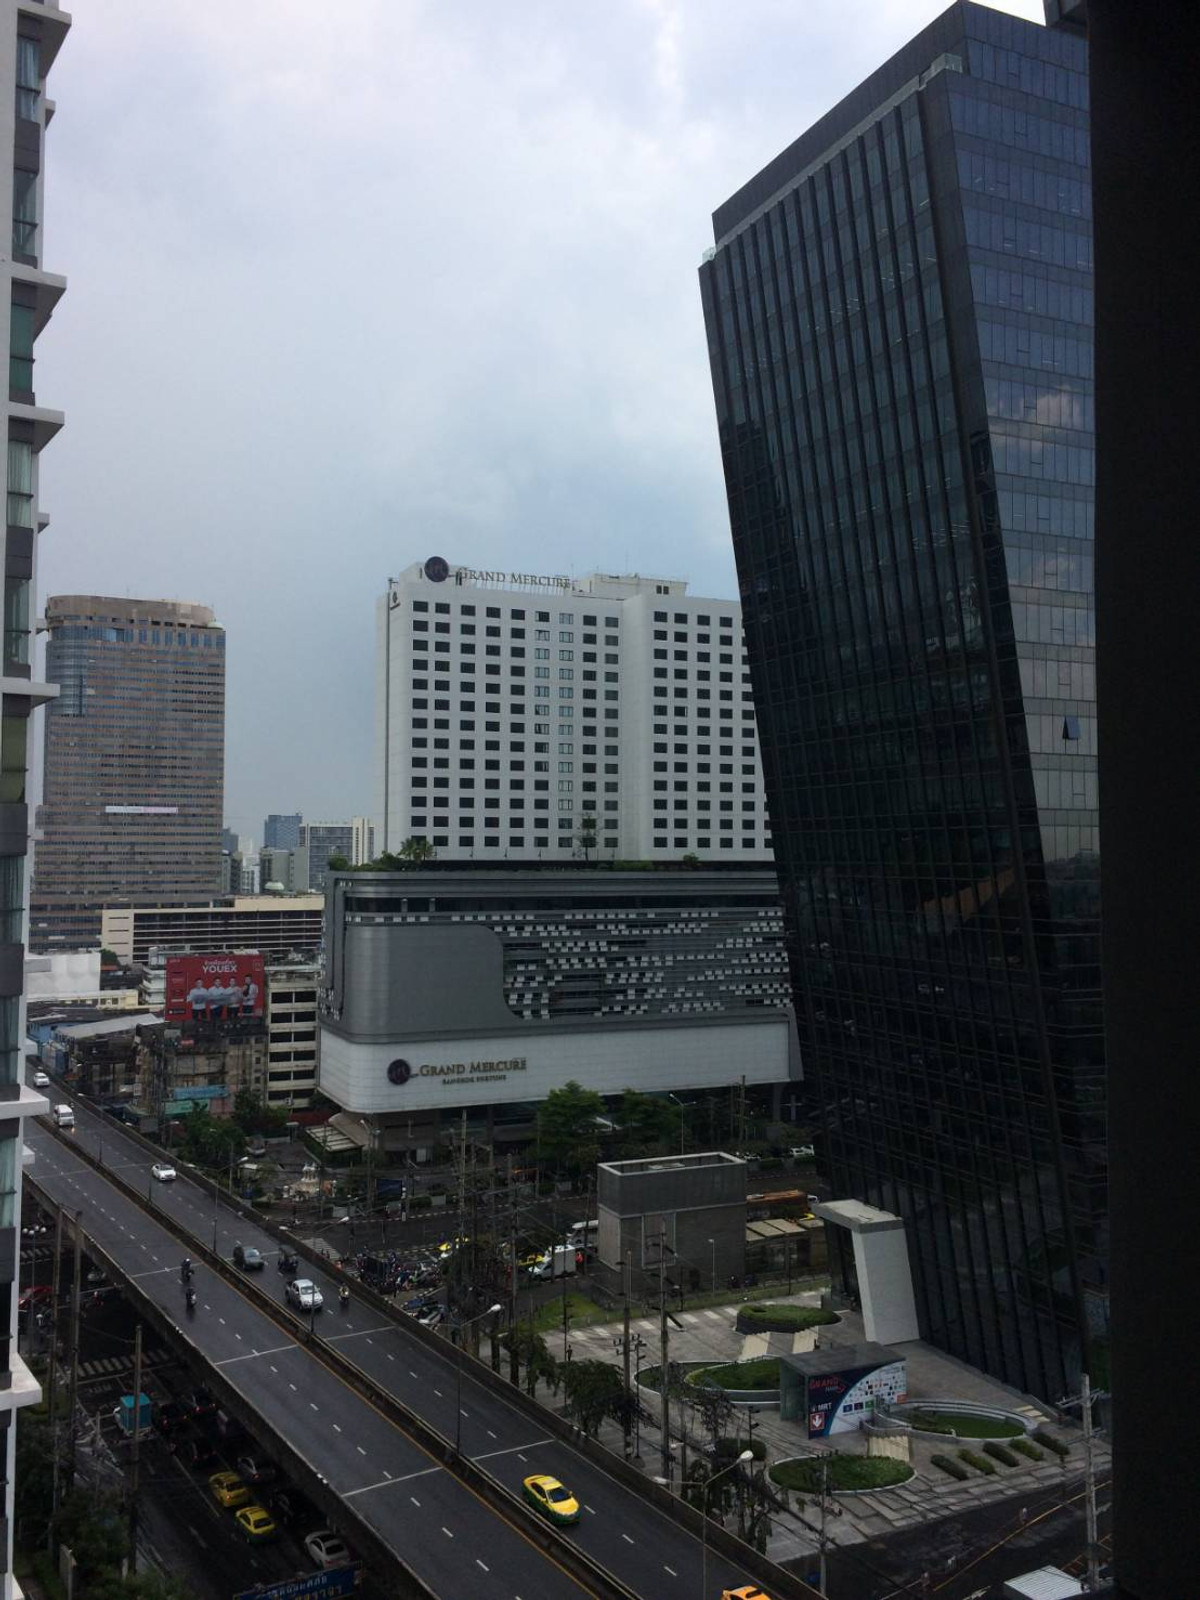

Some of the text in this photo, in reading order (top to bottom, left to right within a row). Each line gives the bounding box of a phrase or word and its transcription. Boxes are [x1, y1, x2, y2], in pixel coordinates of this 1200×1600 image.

[458, 567, 572, 588] GRAND MERCURE
[202, 964, 238, 974] YOUEX
[420, 1059, 527, 1077] GRAND MERCURE
